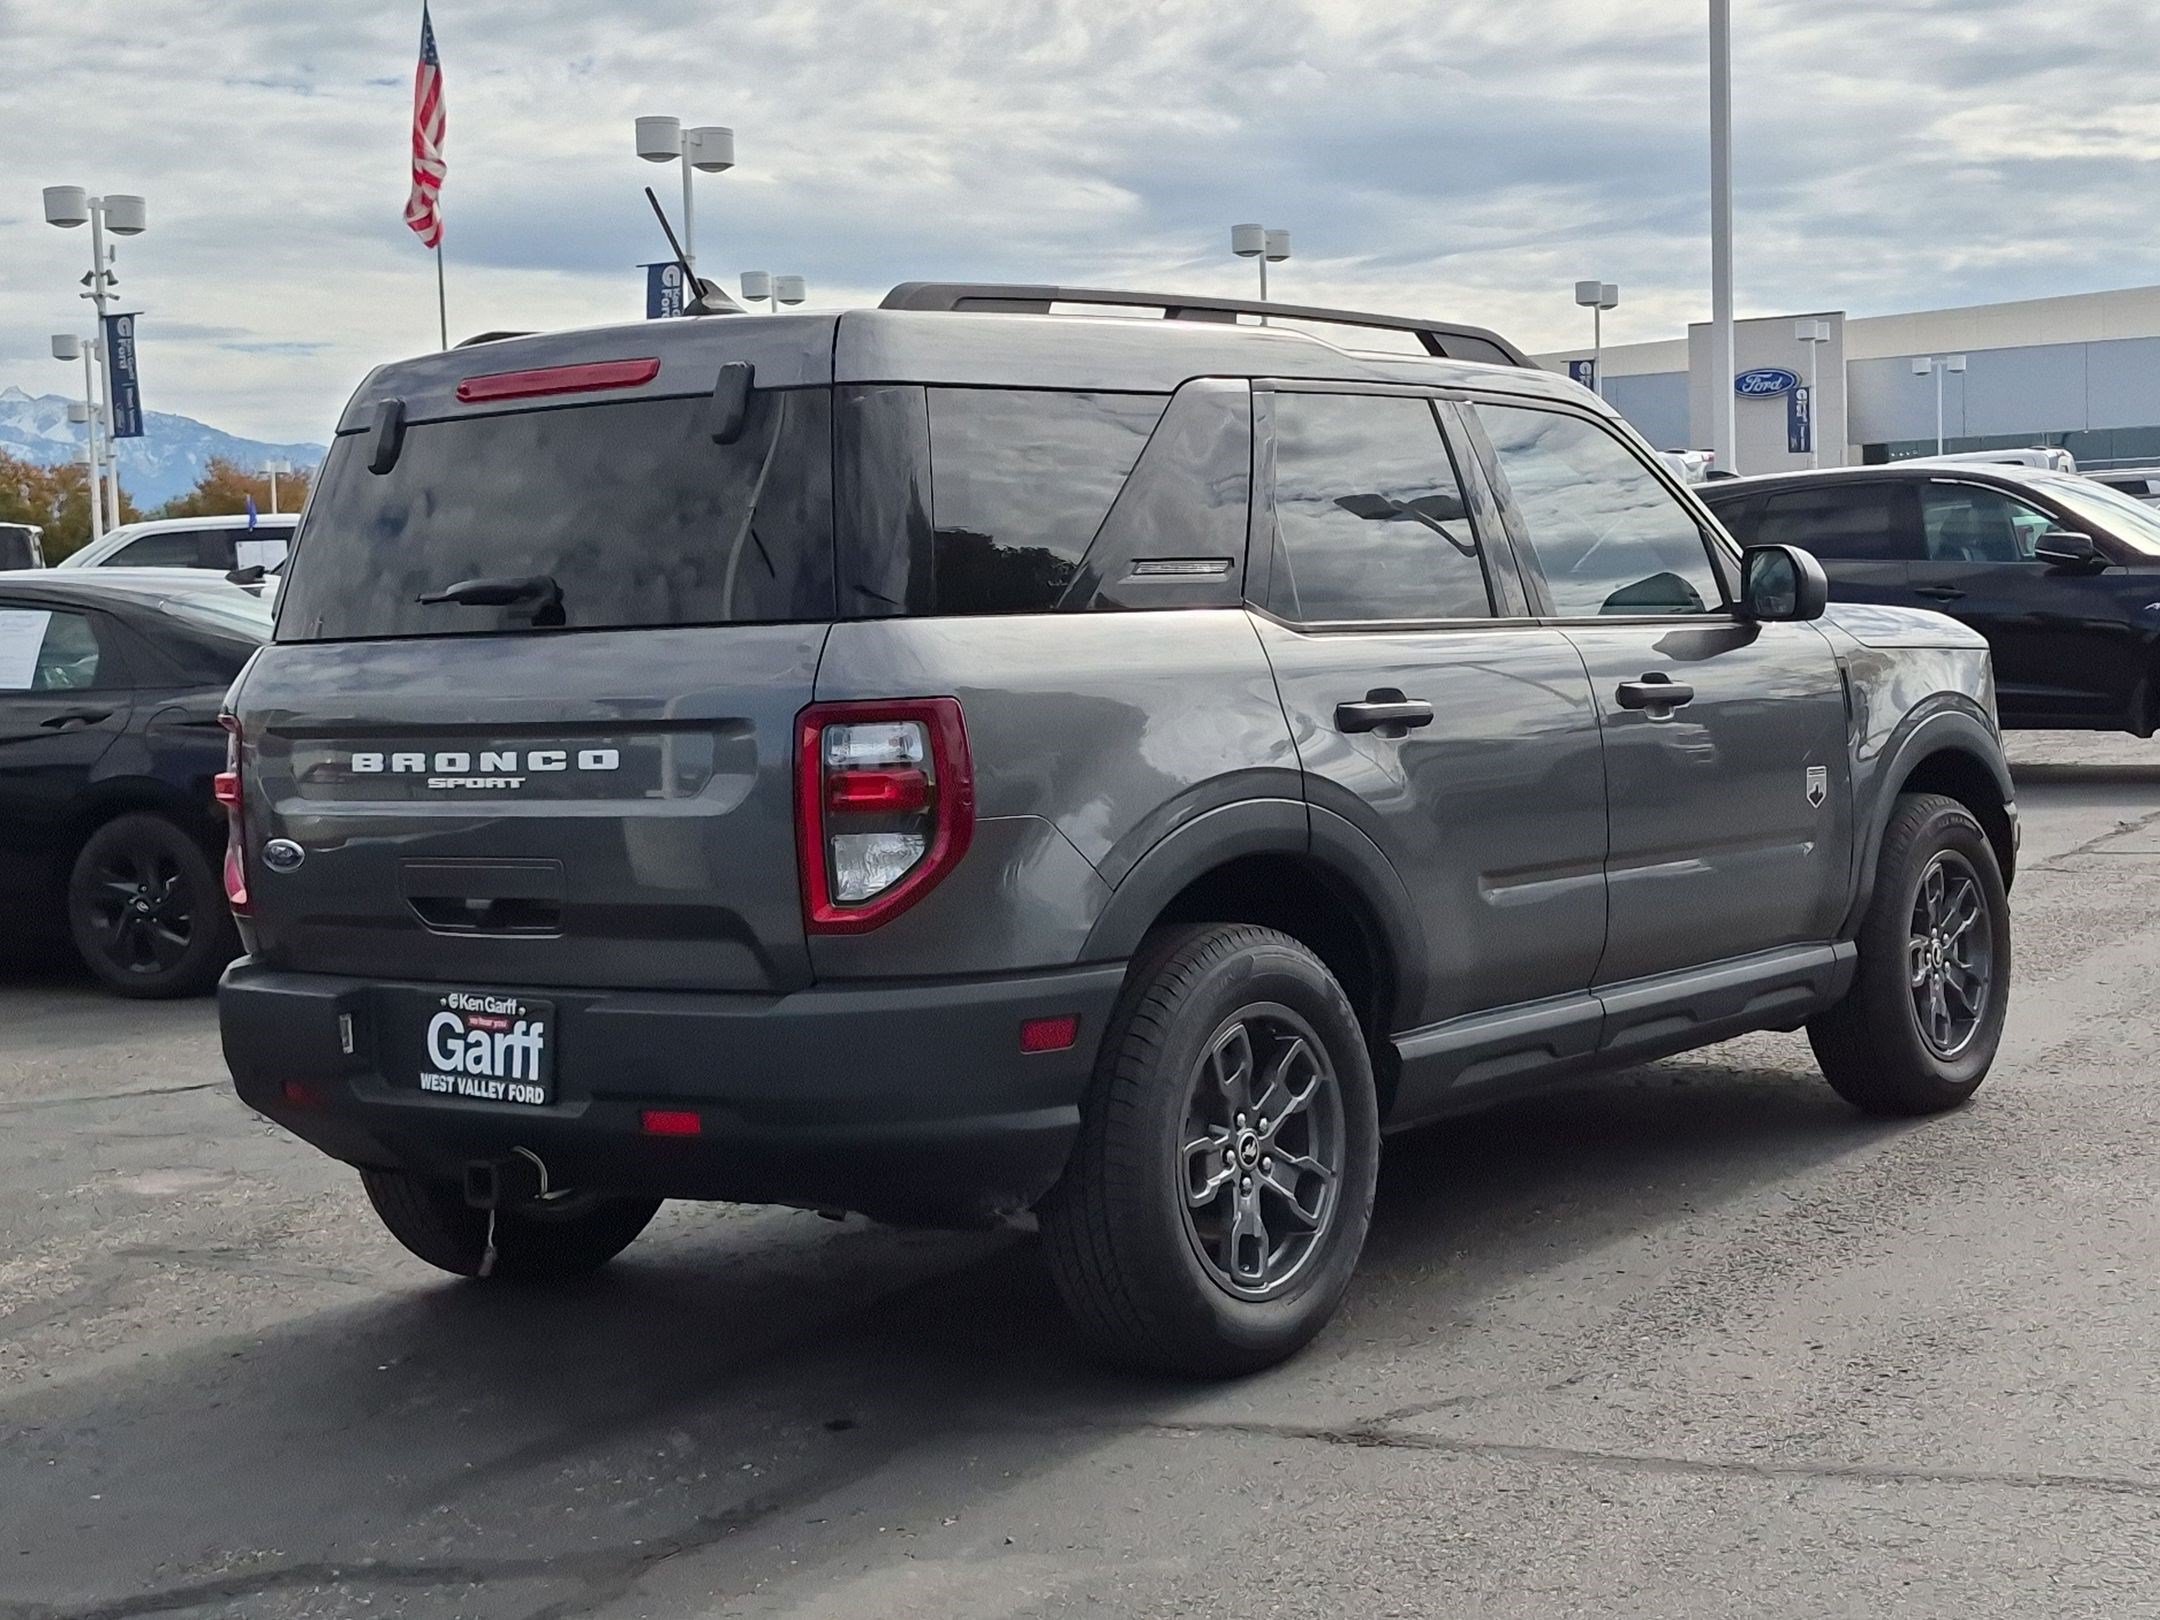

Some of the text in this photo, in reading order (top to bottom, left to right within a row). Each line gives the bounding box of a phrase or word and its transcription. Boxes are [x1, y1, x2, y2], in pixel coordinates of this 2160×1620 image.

[672, 288, 681, 308] Ken
[1742, 373, 1783, 393] Ford
[352, 749, 620, 773] BRONCO
[427, 777, 526, 789] SPORT
[460, 994, 484, 1012] Ken
[485, 997, 517, 1015] Garff
[427, 1011, 544, 1081] Garff
[420, 1073, 545, 1104] WEST VALLEY FORD
